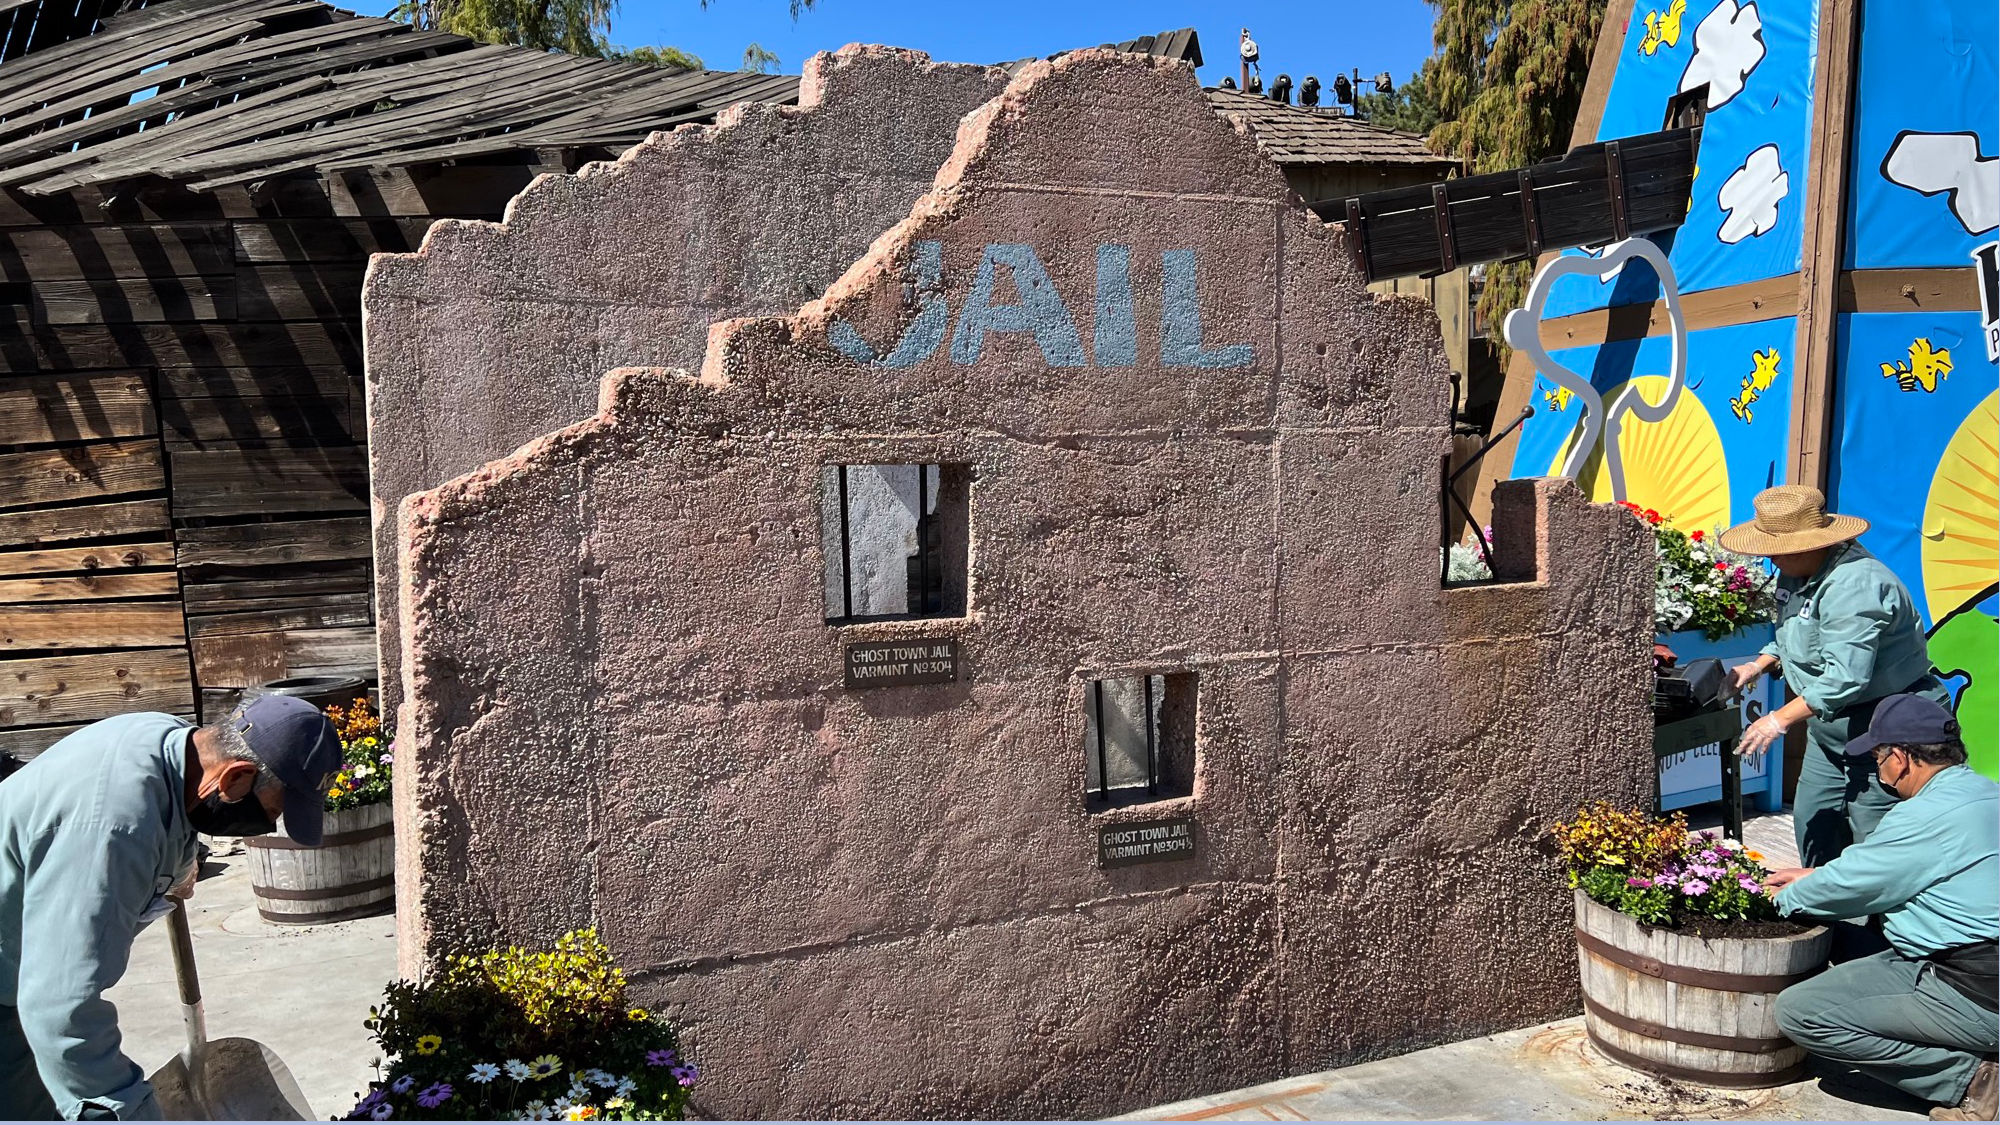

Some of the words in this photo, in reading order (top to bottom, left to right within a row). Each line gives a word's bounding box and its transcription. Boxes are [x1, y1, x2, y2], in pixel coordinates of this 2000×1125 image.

[828, 240, 1255, 369] JAIL
[852, 649, 890, 663] GHOST
[893, 647, 927, 661] TOWN
[931, 645, 951, 658] JAIL
[853, 664, 908, 678] VARMINT
[1104, 831, 1137, 845] GHOST
[1140, 827, 1169, 841] TOWN
[1171, 824, 1189, 838] JAIL
[1105, 844, 1151, 859] VARMINT
